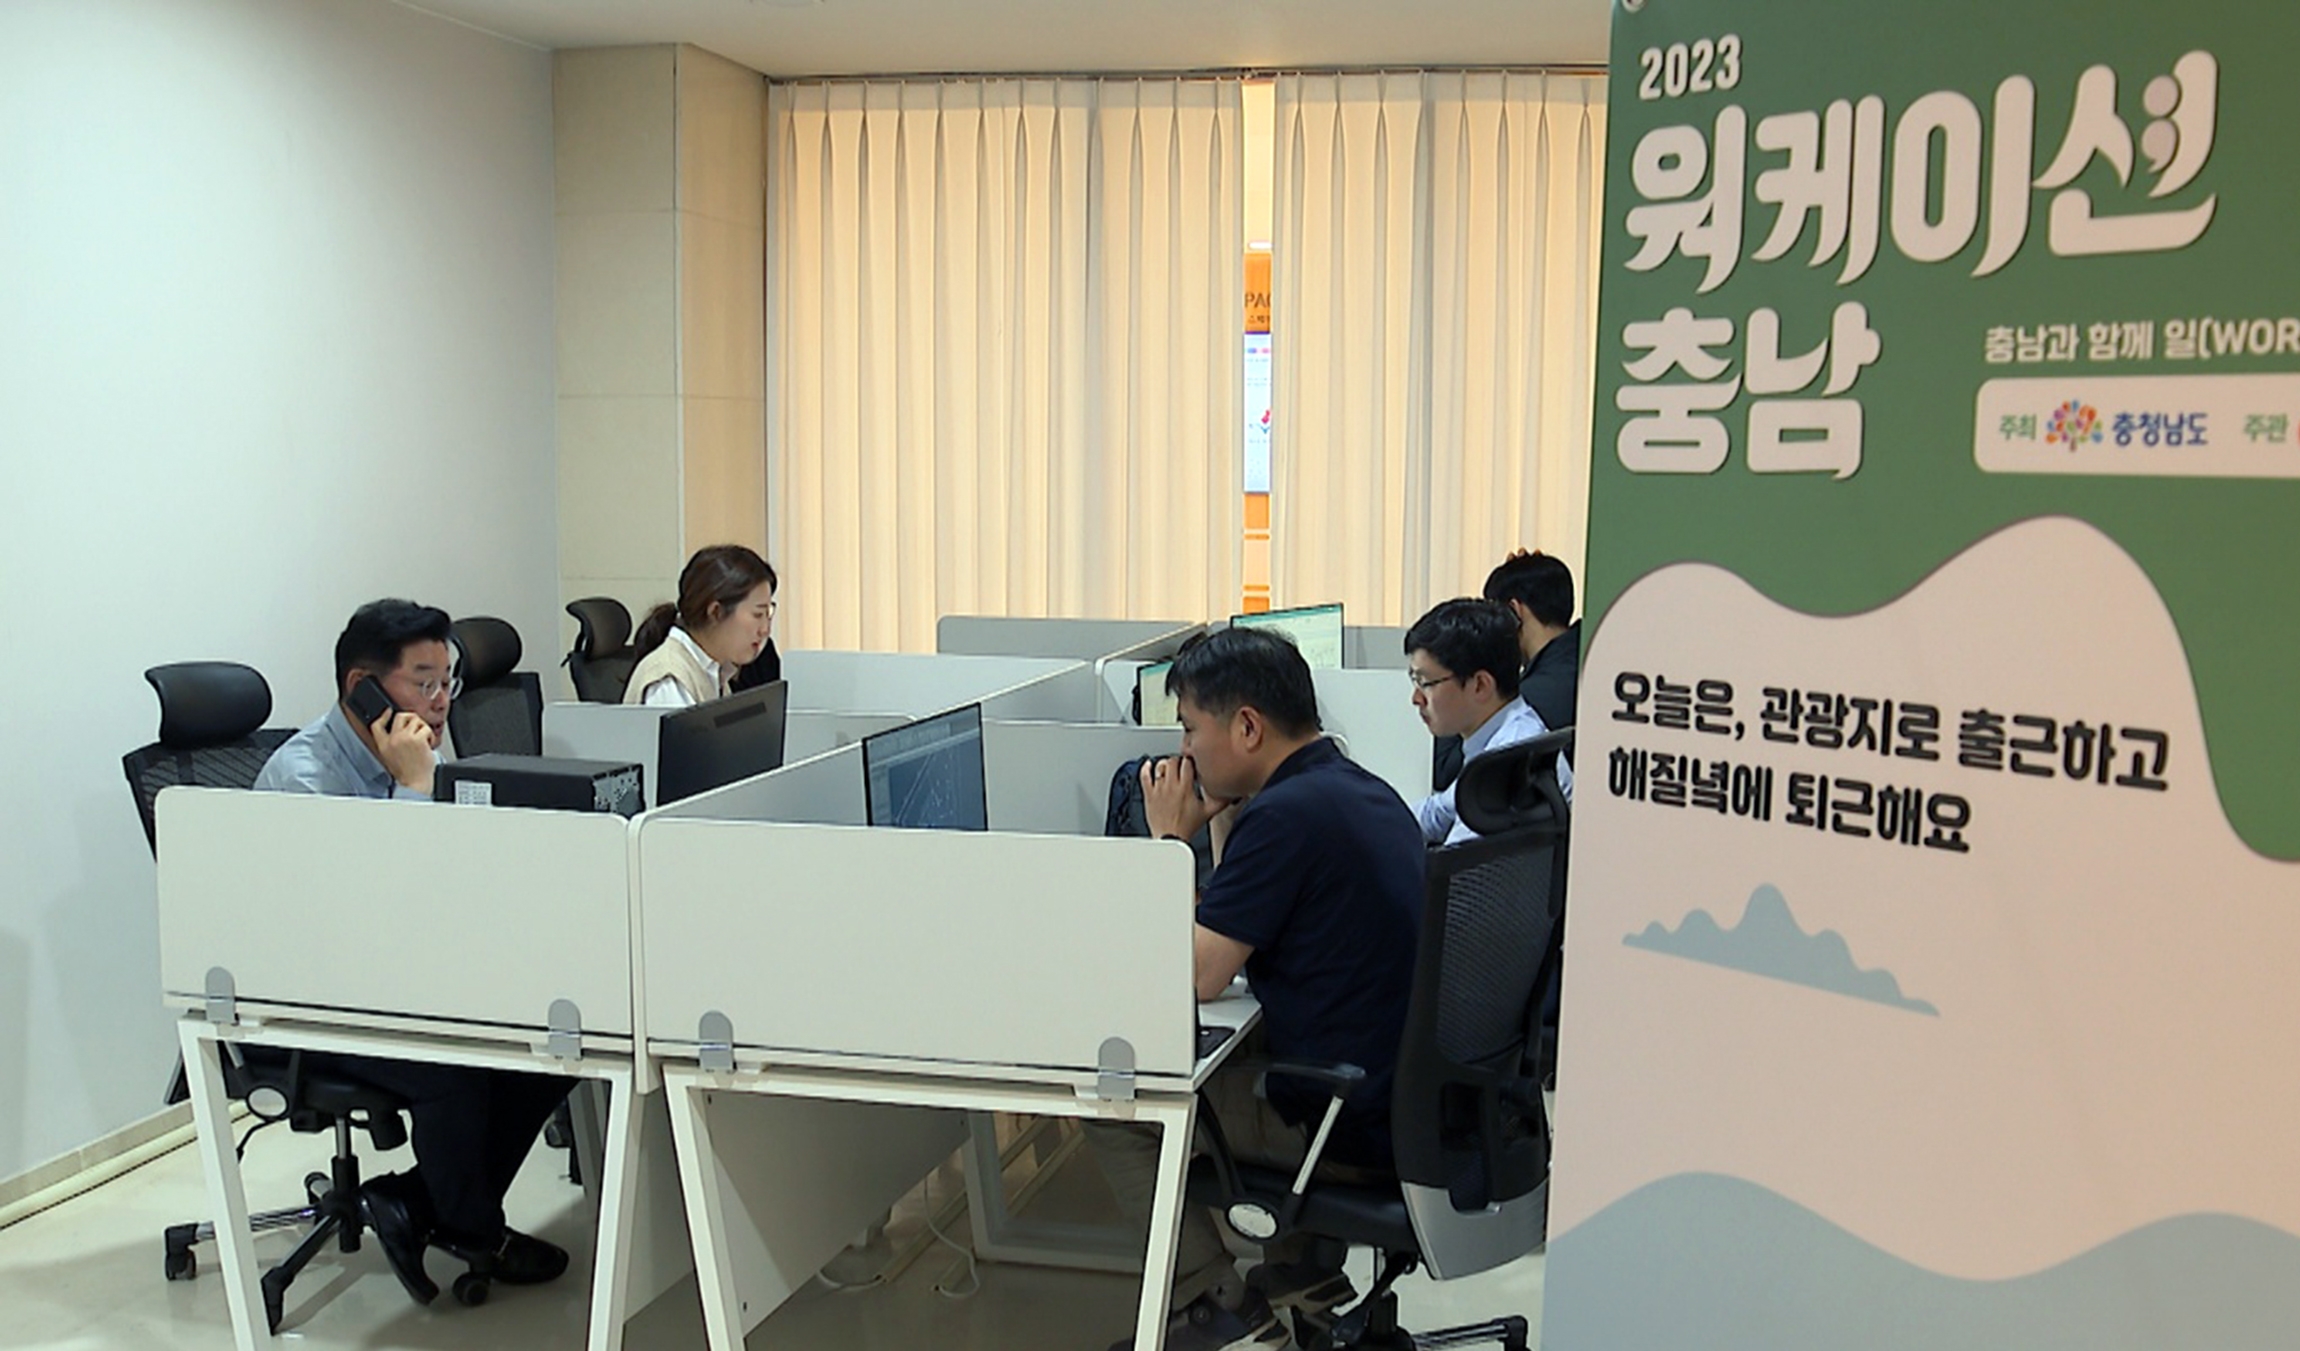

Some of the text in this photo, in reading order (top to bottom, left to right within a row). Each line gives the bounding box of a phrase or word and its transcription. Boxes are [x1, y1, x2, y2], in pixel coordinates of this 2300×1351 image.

[1639, 34, 1742, 100] 2023
[1623, 50, 2219, 294] 워케이션
[1615, 301, 1882, 480] 충남
[1985, 324, 2080, 363] 충남과
[2088, 321, 2154, 361] 함께
[1999, 411, 2289, 447] 주최 충청남도 주관
[1611, 671, 2169, 792] 오늘은, 관광지로 출근하고
[1608, 746, 1972, 854] 해질녘에 퇴근해요
